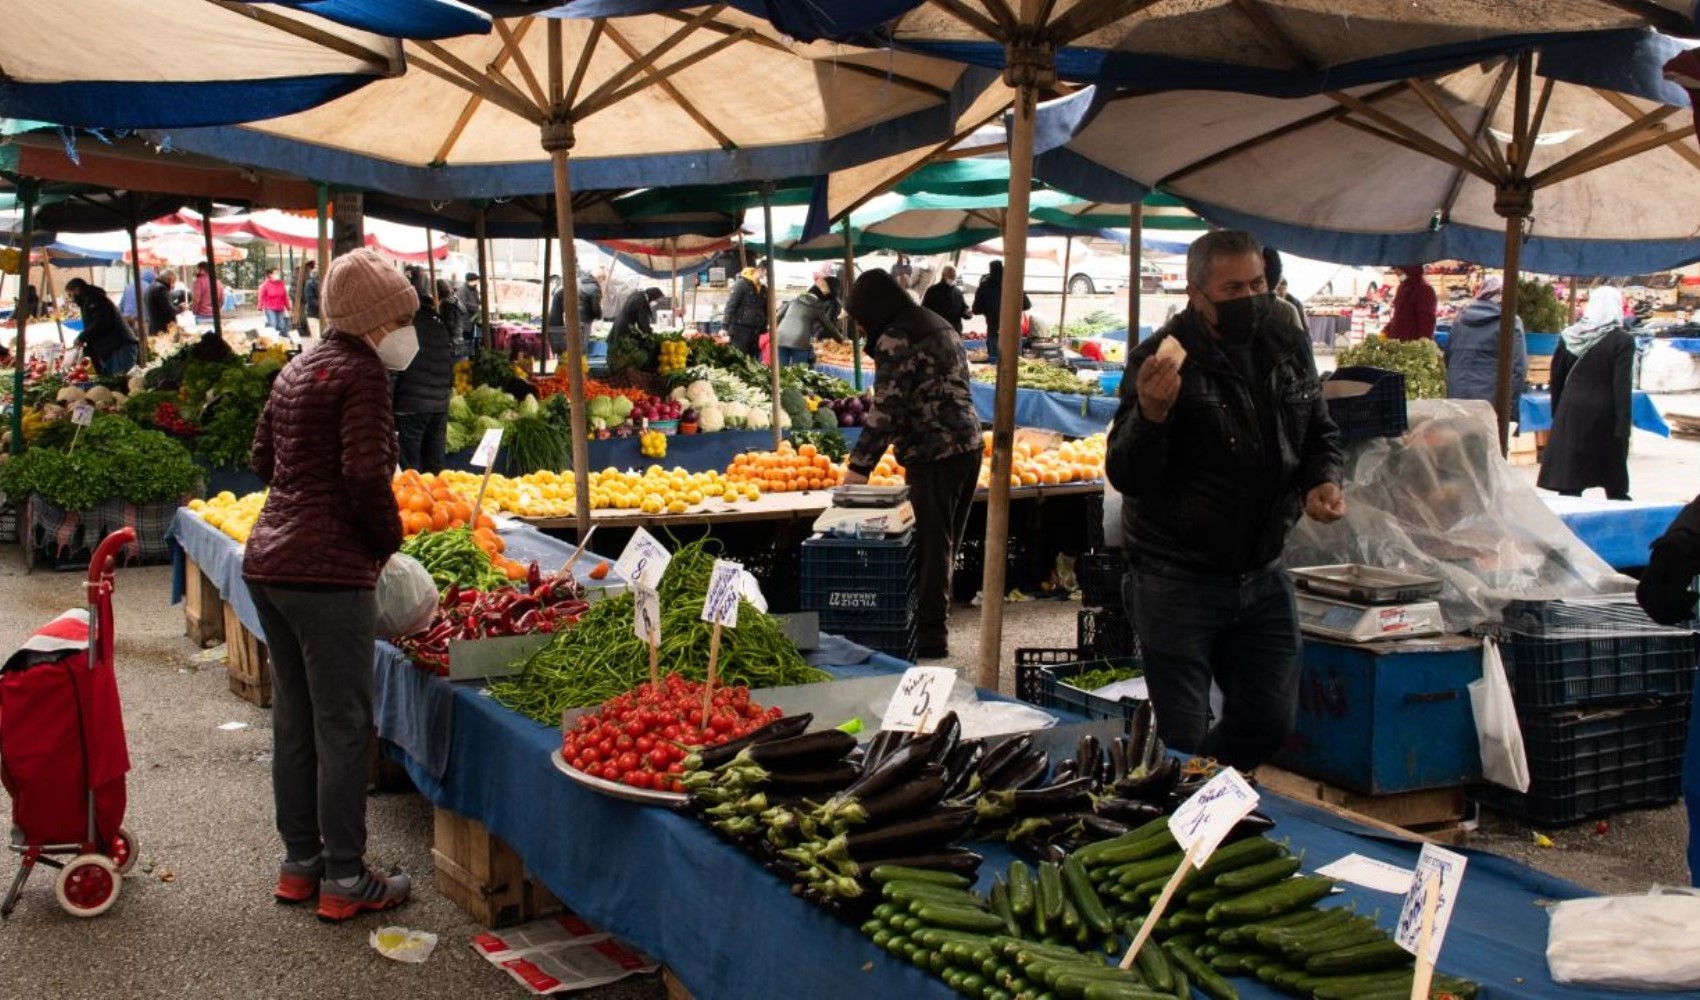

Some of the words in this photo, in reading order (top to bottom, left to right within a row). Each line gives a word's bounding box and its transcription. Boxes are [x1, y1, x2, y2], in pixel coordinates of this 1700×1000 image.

[631, 557, 648, 580] 8
[841, 599, 877, 607] YILDIZ
[912, 675, 935, 716] 5
